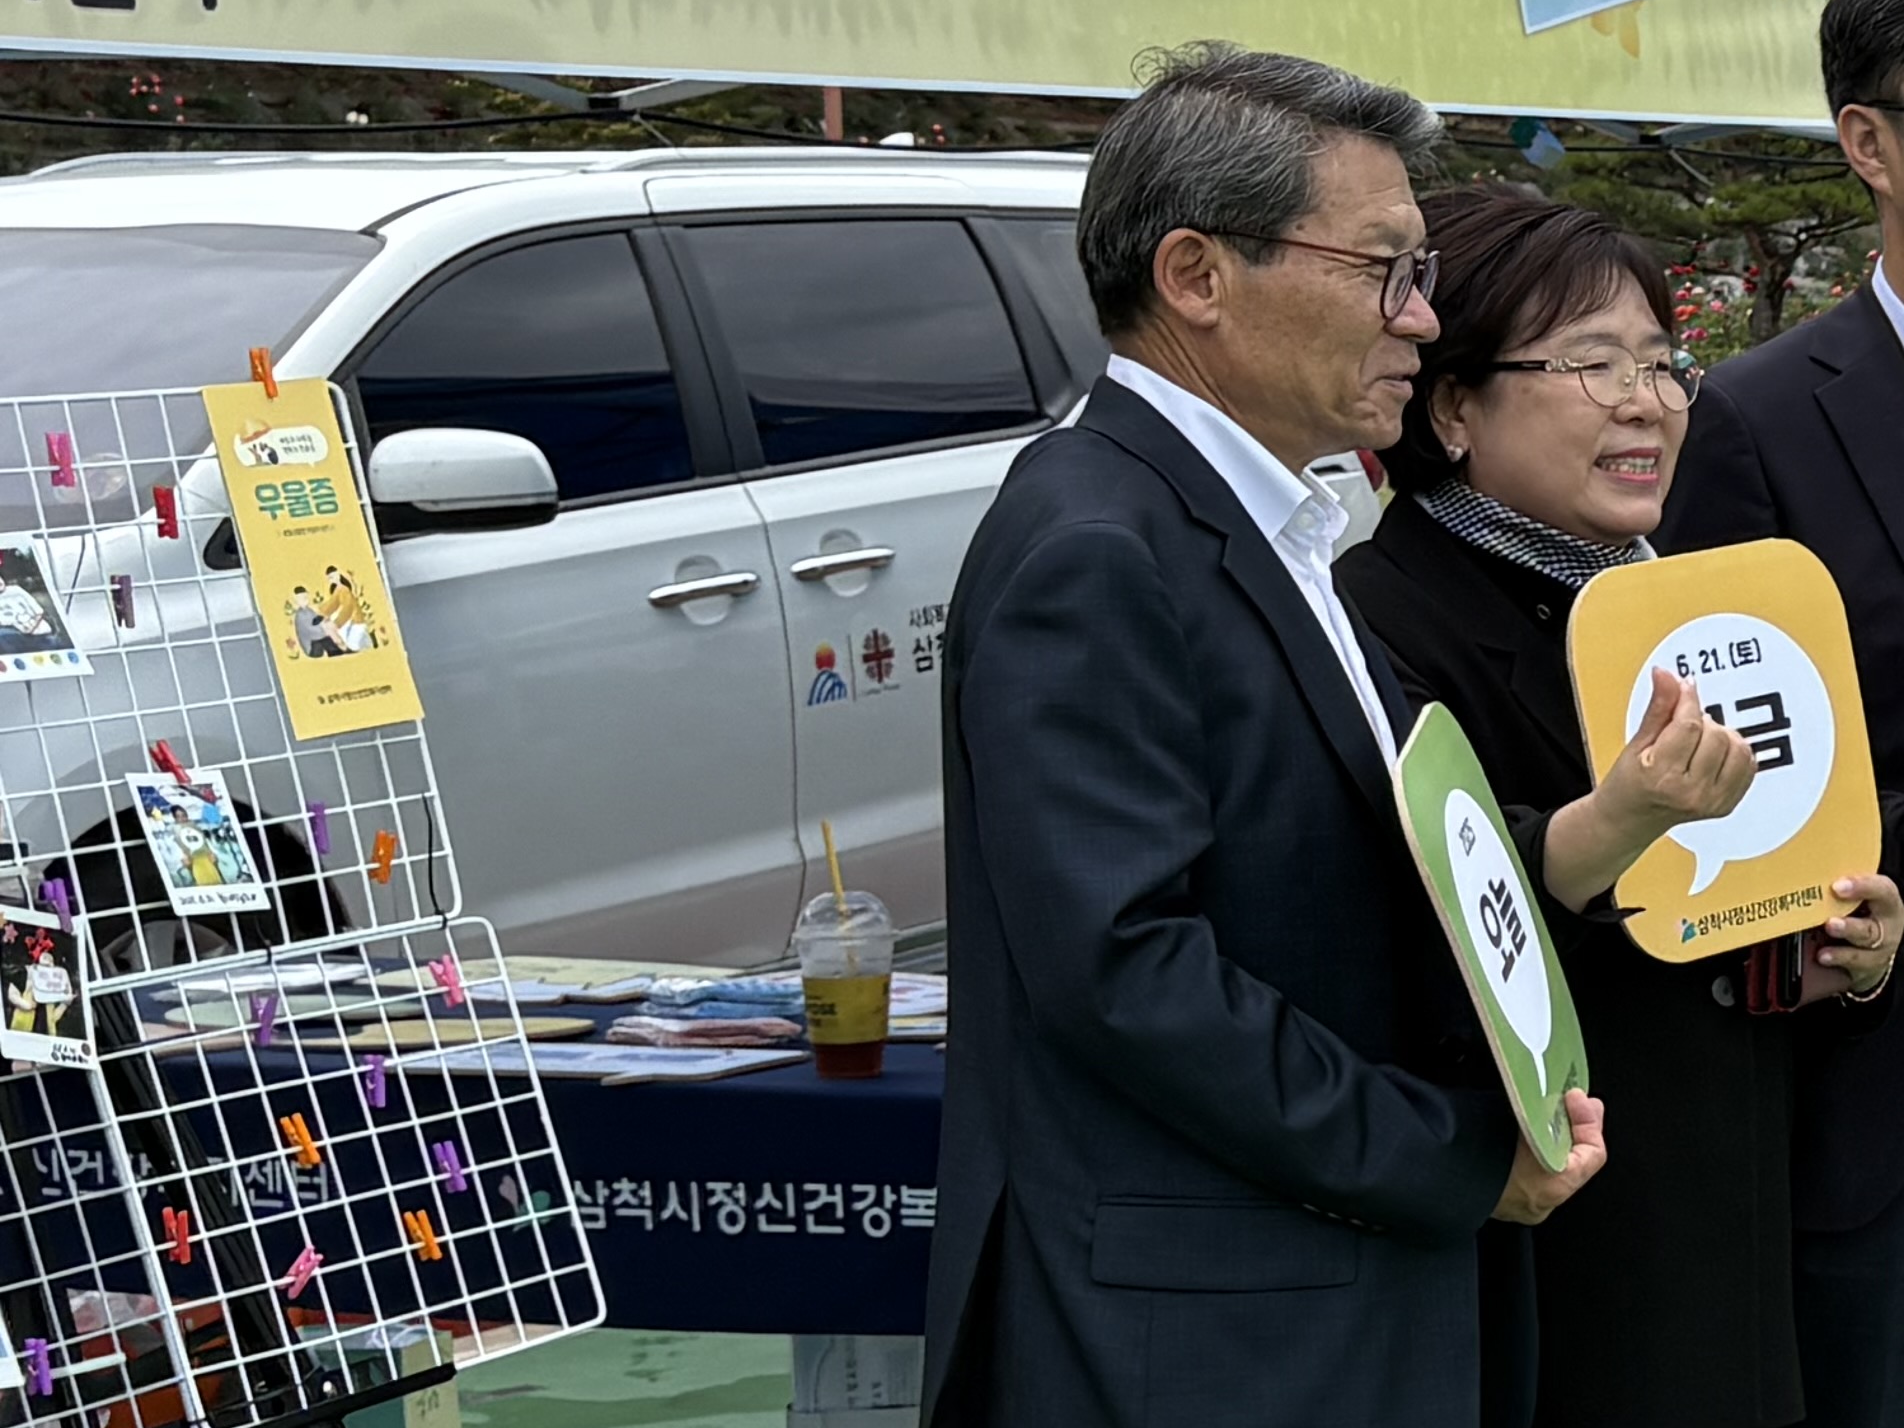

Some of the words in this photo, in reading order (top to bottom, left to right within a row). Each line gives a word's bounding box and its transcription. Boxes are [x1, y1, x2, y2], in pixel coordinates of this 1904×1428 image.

[254, 478, 339, 521] 우울증
[1698, 648, 1726, 674] 21.
[1728, 637, 1762, 668] (토)
[1704, 691, 1794, 772] 금
[1479, 878, 1528, 984] 오늘
